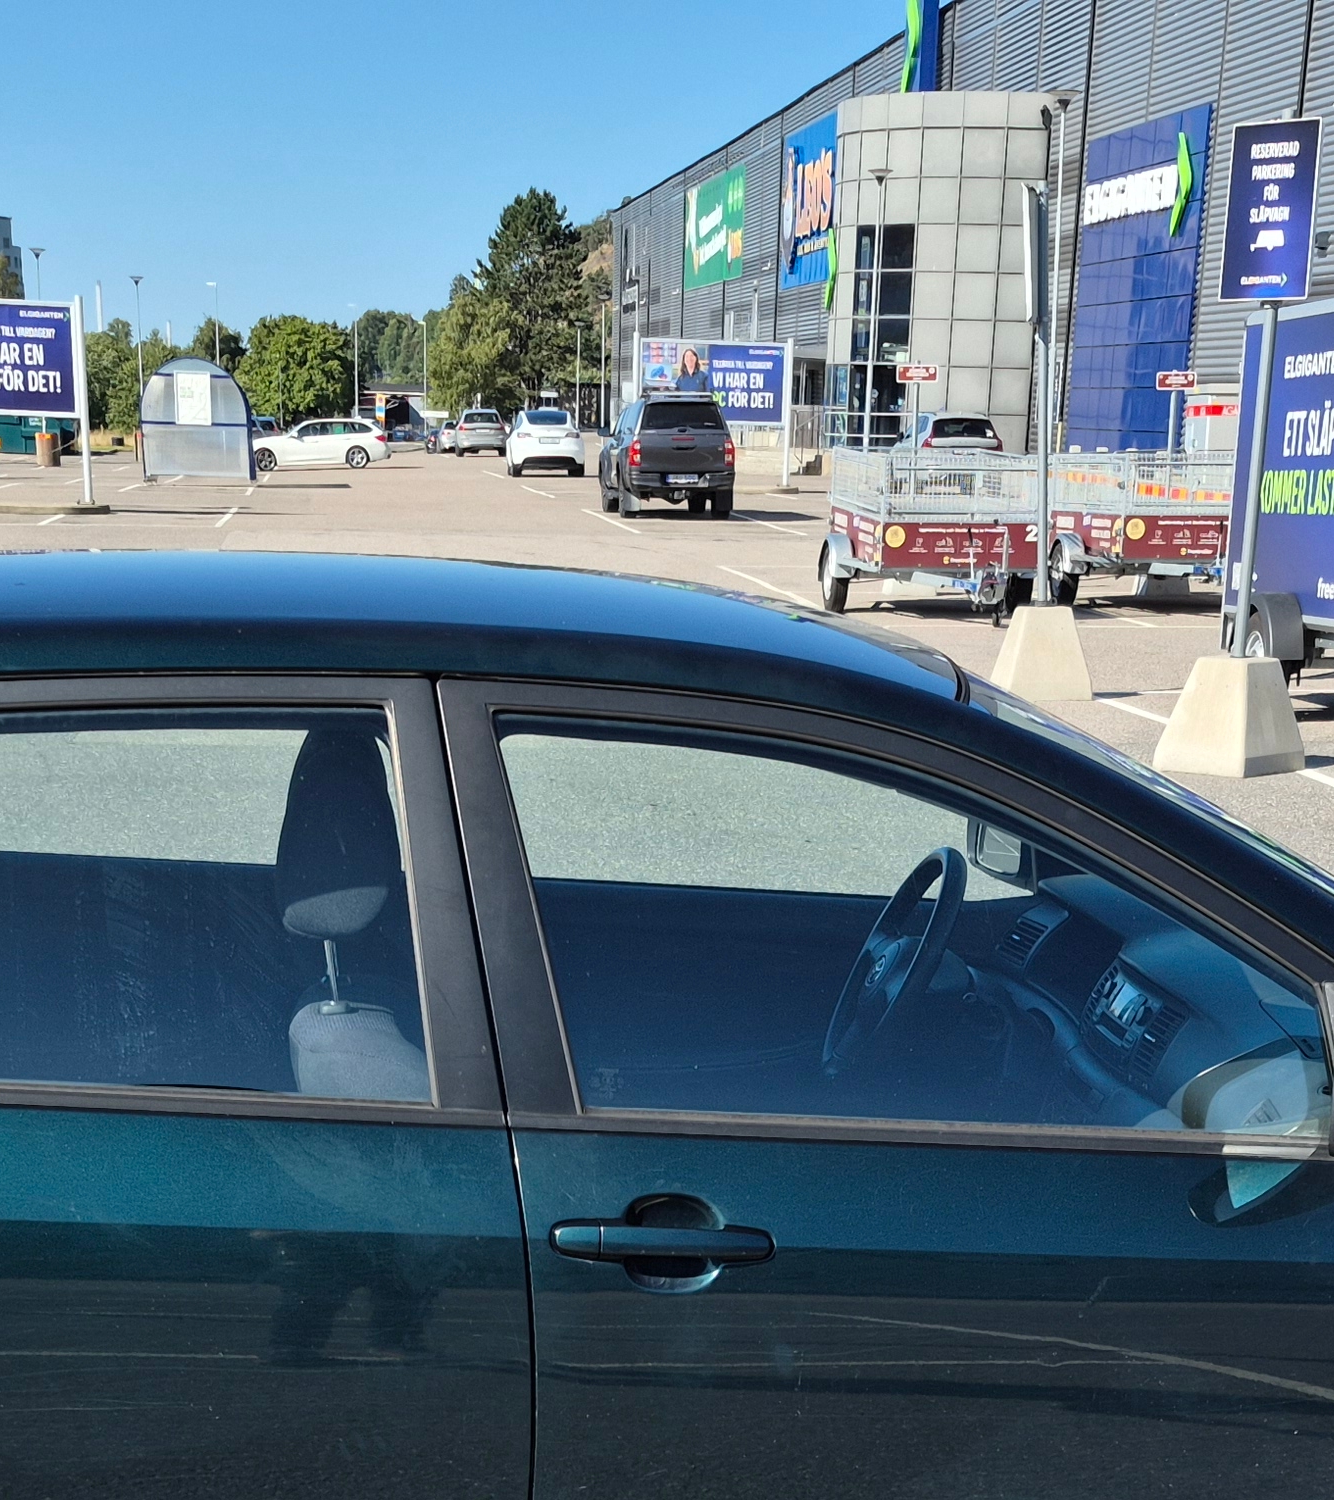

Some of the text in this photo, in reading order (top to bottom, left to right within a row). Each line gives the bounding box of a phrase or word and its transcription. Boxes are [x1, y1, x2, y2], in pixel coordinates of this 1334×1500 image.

[1251, 141, 1300, 159] RESERVERAD
[1252, 163, 1295, 180] PARKERING
[1263, 183, 1280, 201] FÖR
[1249, 205, 1290, 223] SLÄPVAGN
[23, 343, 44, 366] EN
[27, 370, 62, 393] DET!
[712, 372, 764, 389] VI HAR EN
[728, 389, 749, 408] FÖR
[750, 392, 774, 409] DET!
[1283, 410, 1308, 457] ETT
[1025, 525, 1038, 542] 2
